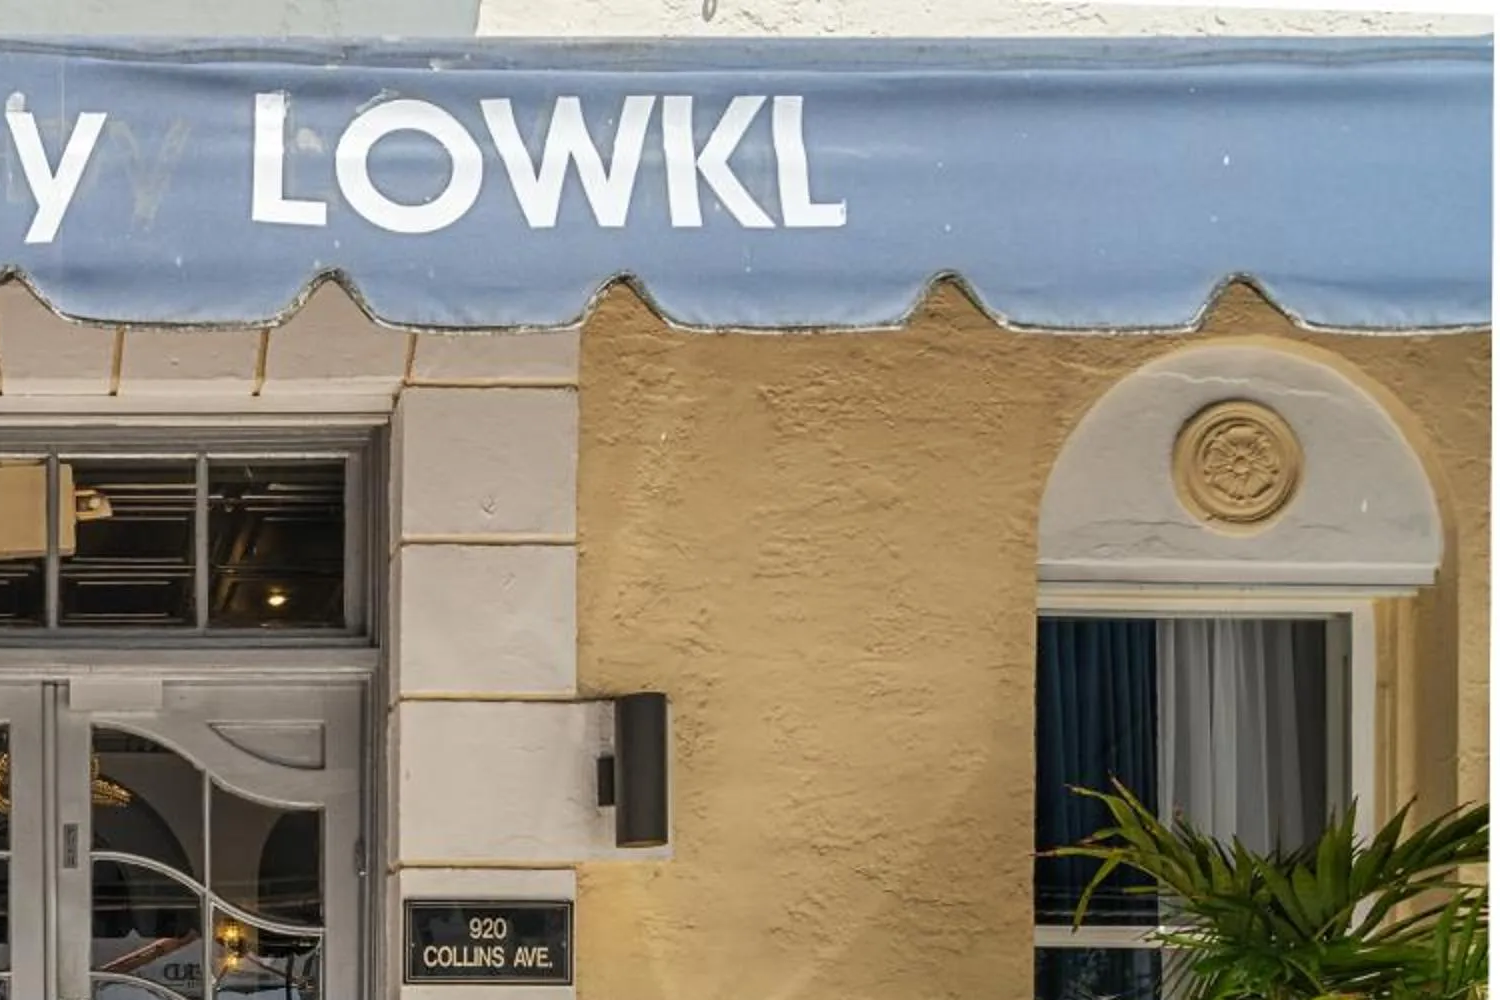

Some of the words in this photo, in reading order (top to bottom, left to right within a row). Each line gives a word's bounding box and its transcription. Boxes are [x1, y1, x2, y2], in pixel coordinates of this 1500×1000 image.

[250, 93, 848, 234] LOWKL
[468, 917, 508, 940] 920
[422, 944, 506, 968] COLLINS
[512, 945, 554, 969] AVE.
